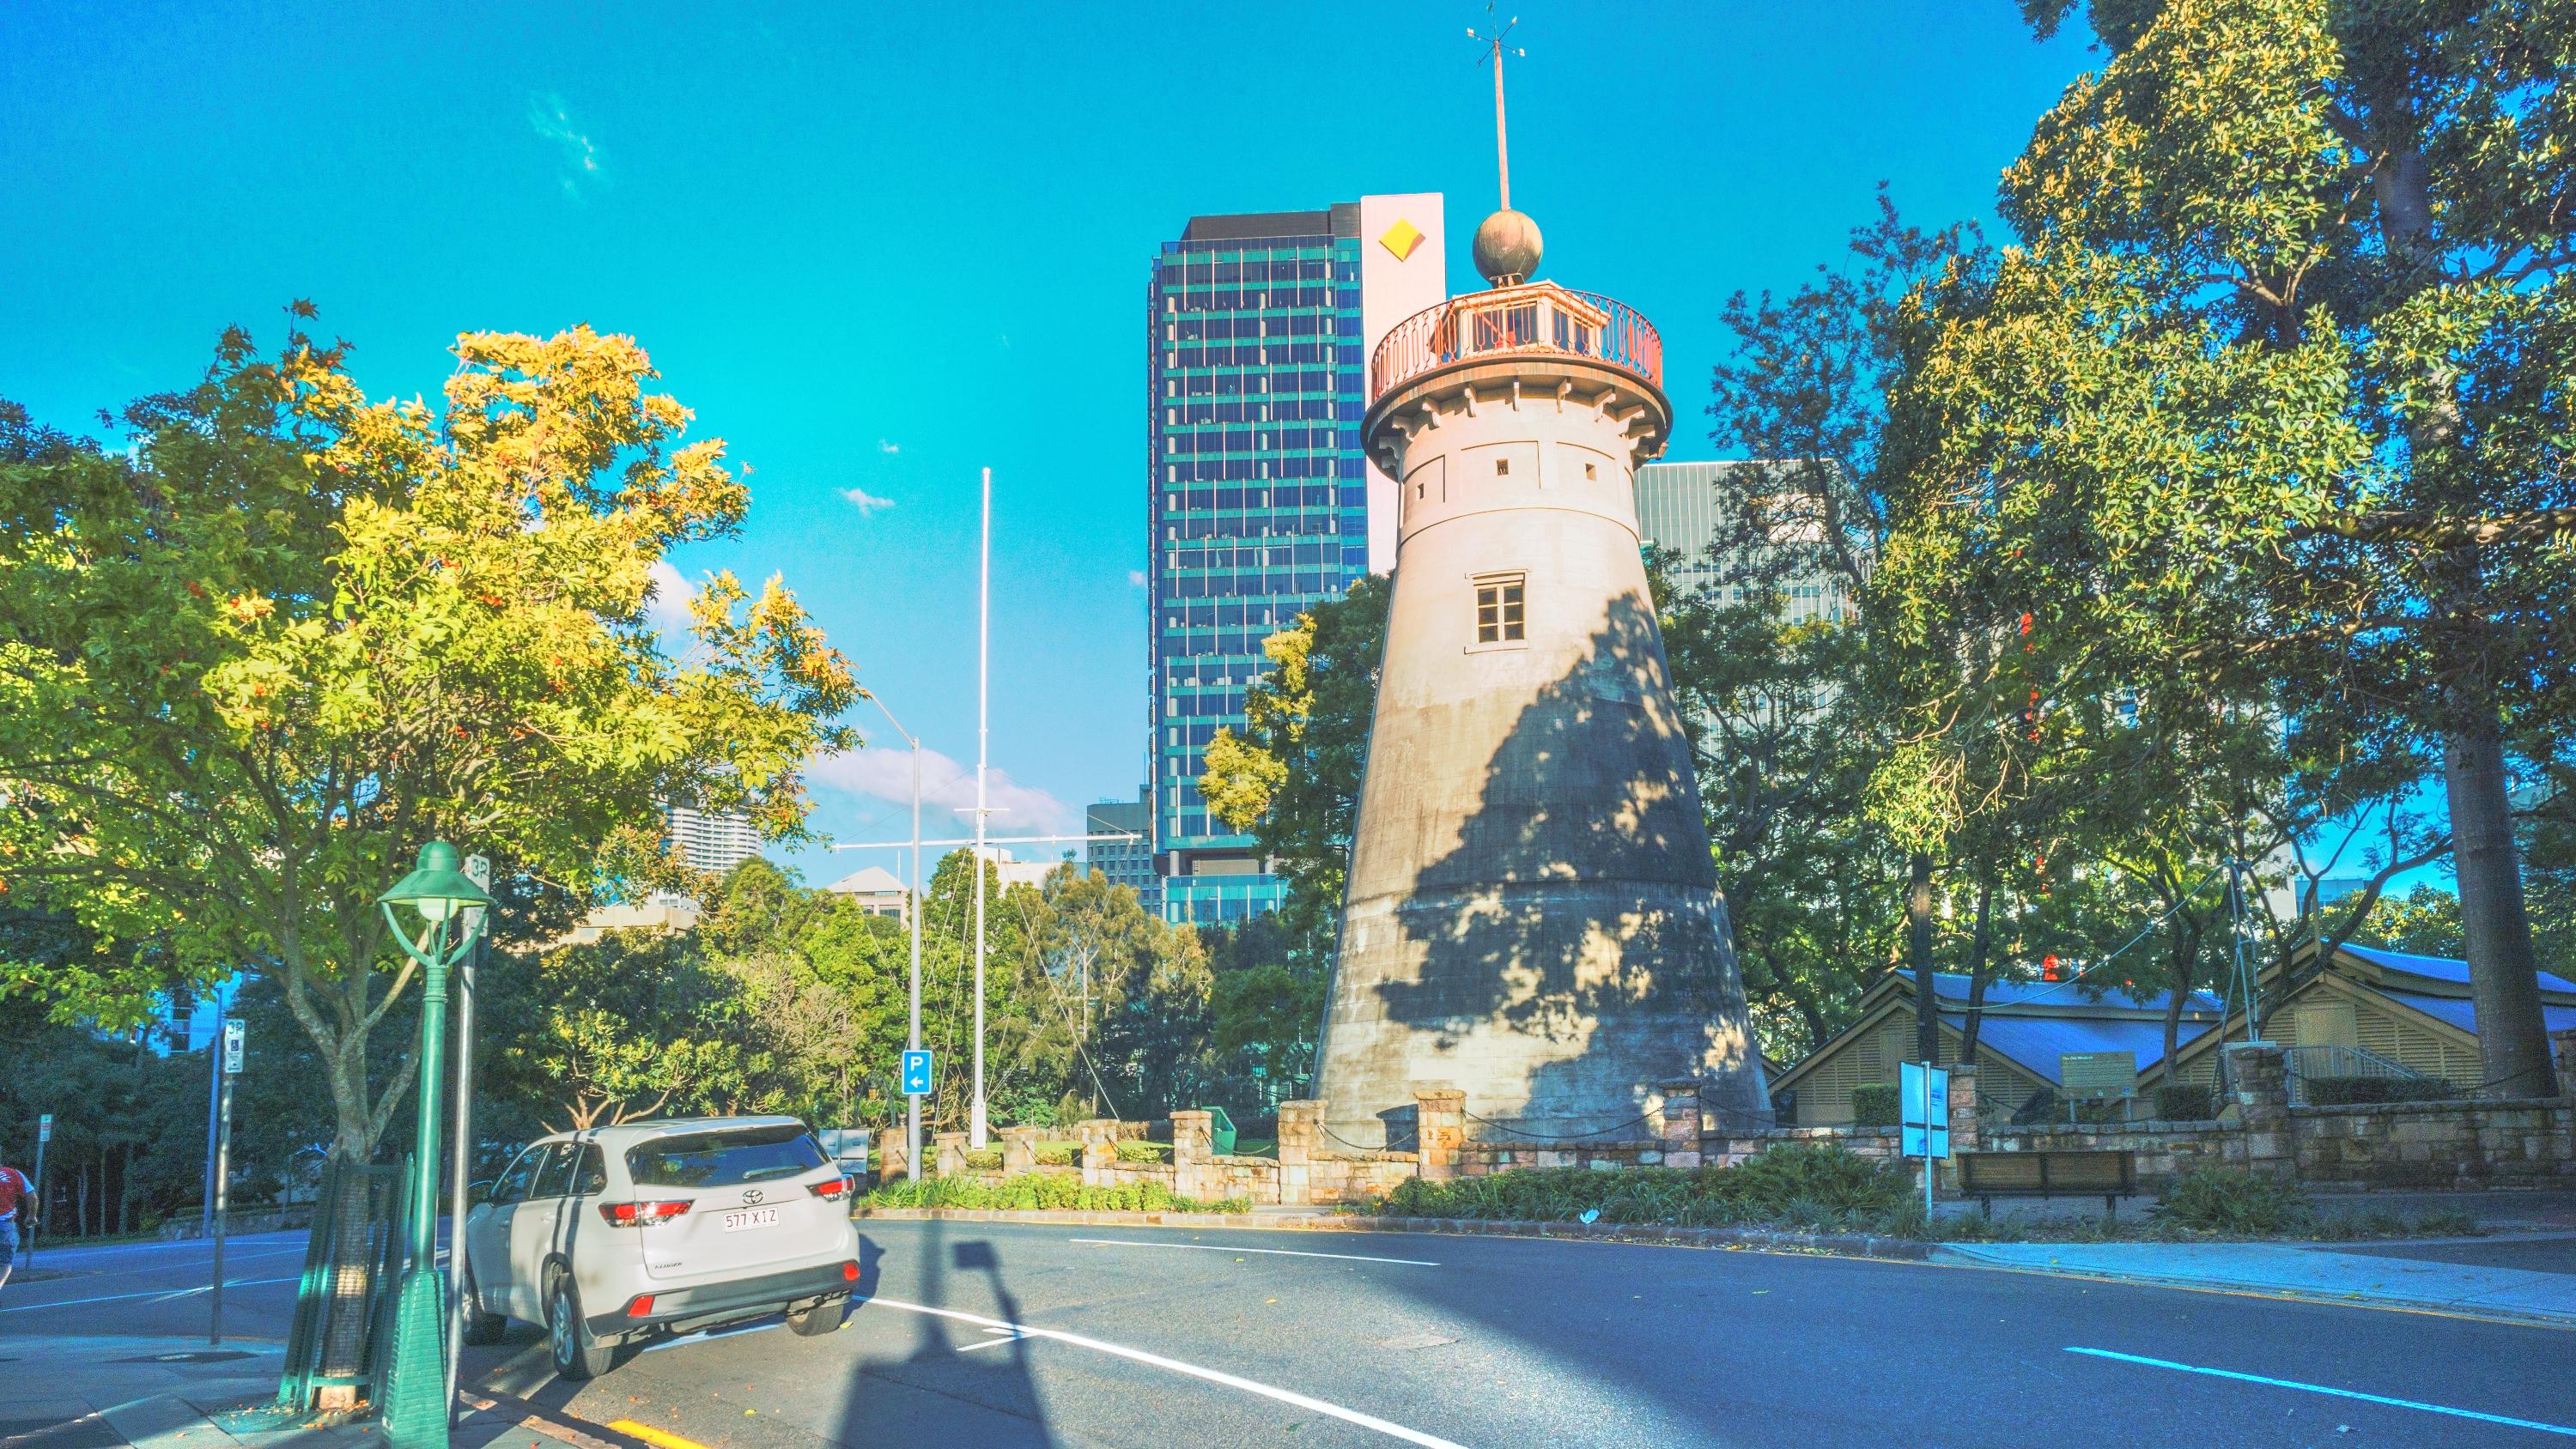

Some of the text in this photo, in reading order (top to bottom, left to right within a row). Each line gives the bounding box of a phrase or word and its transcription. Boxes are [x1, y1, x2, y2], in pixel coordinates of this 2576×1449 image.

[910, 1056, 923, 1071] P
[726, 1210, 776, 1228] 577 XIZ
